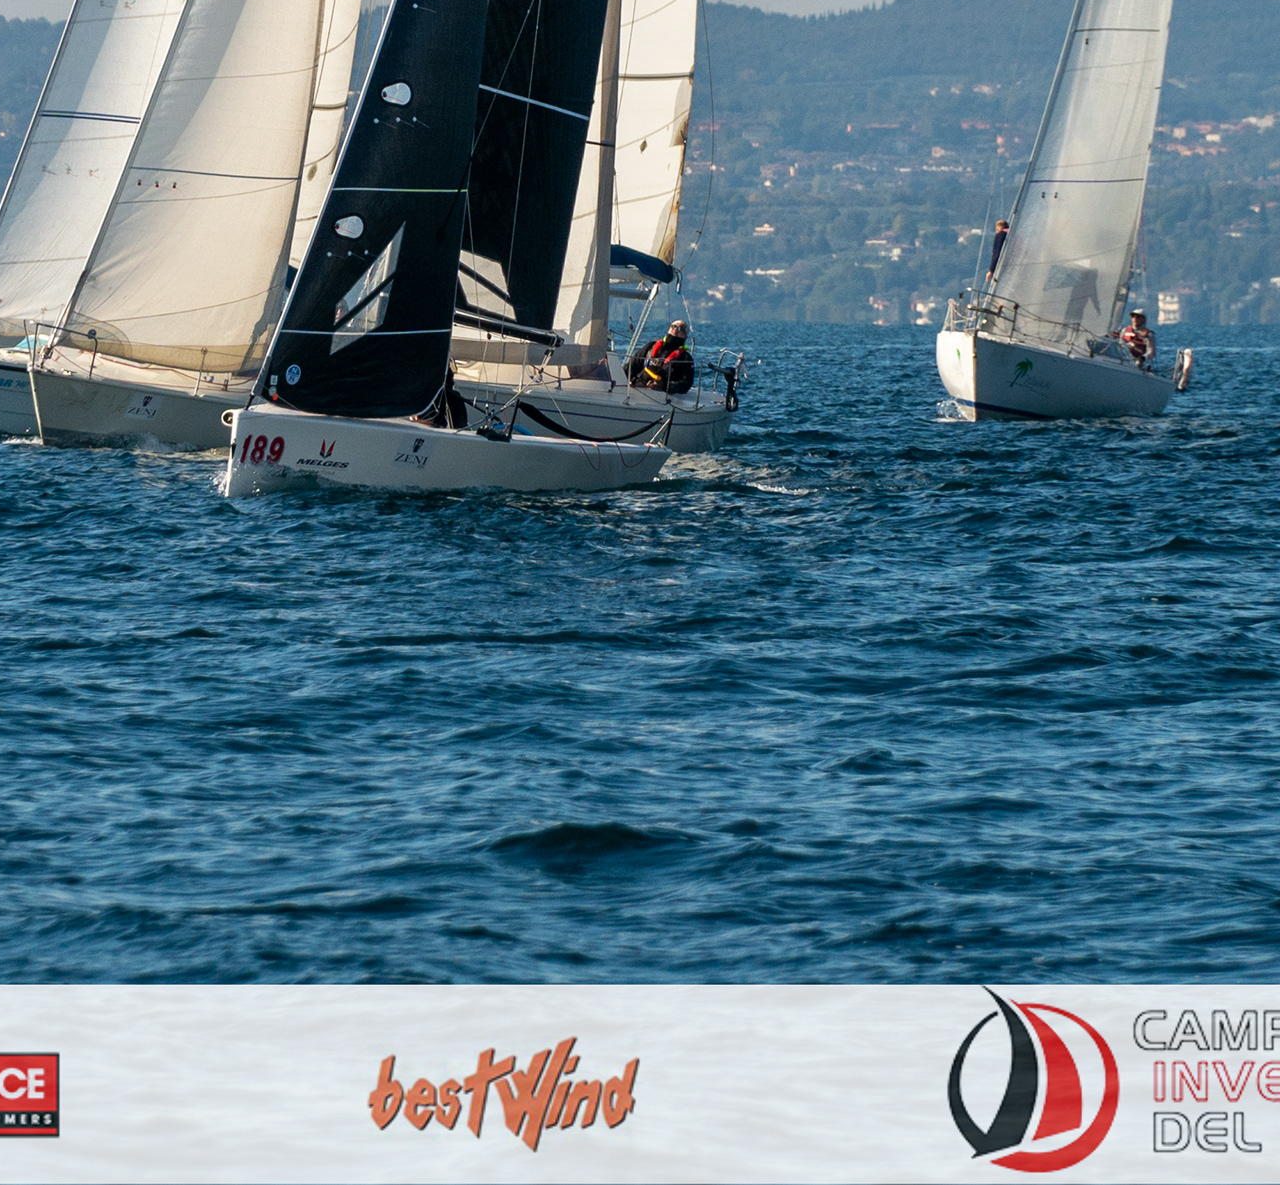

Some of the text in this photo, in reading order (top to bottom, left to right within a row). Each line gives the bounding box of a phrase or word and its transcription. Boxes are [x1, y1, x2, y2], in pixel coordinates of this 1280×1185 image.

[239, 434, 285, 465] 189
[296, 458, 350, 469] MELGES
[394, 452, 429, 465] ZENI
